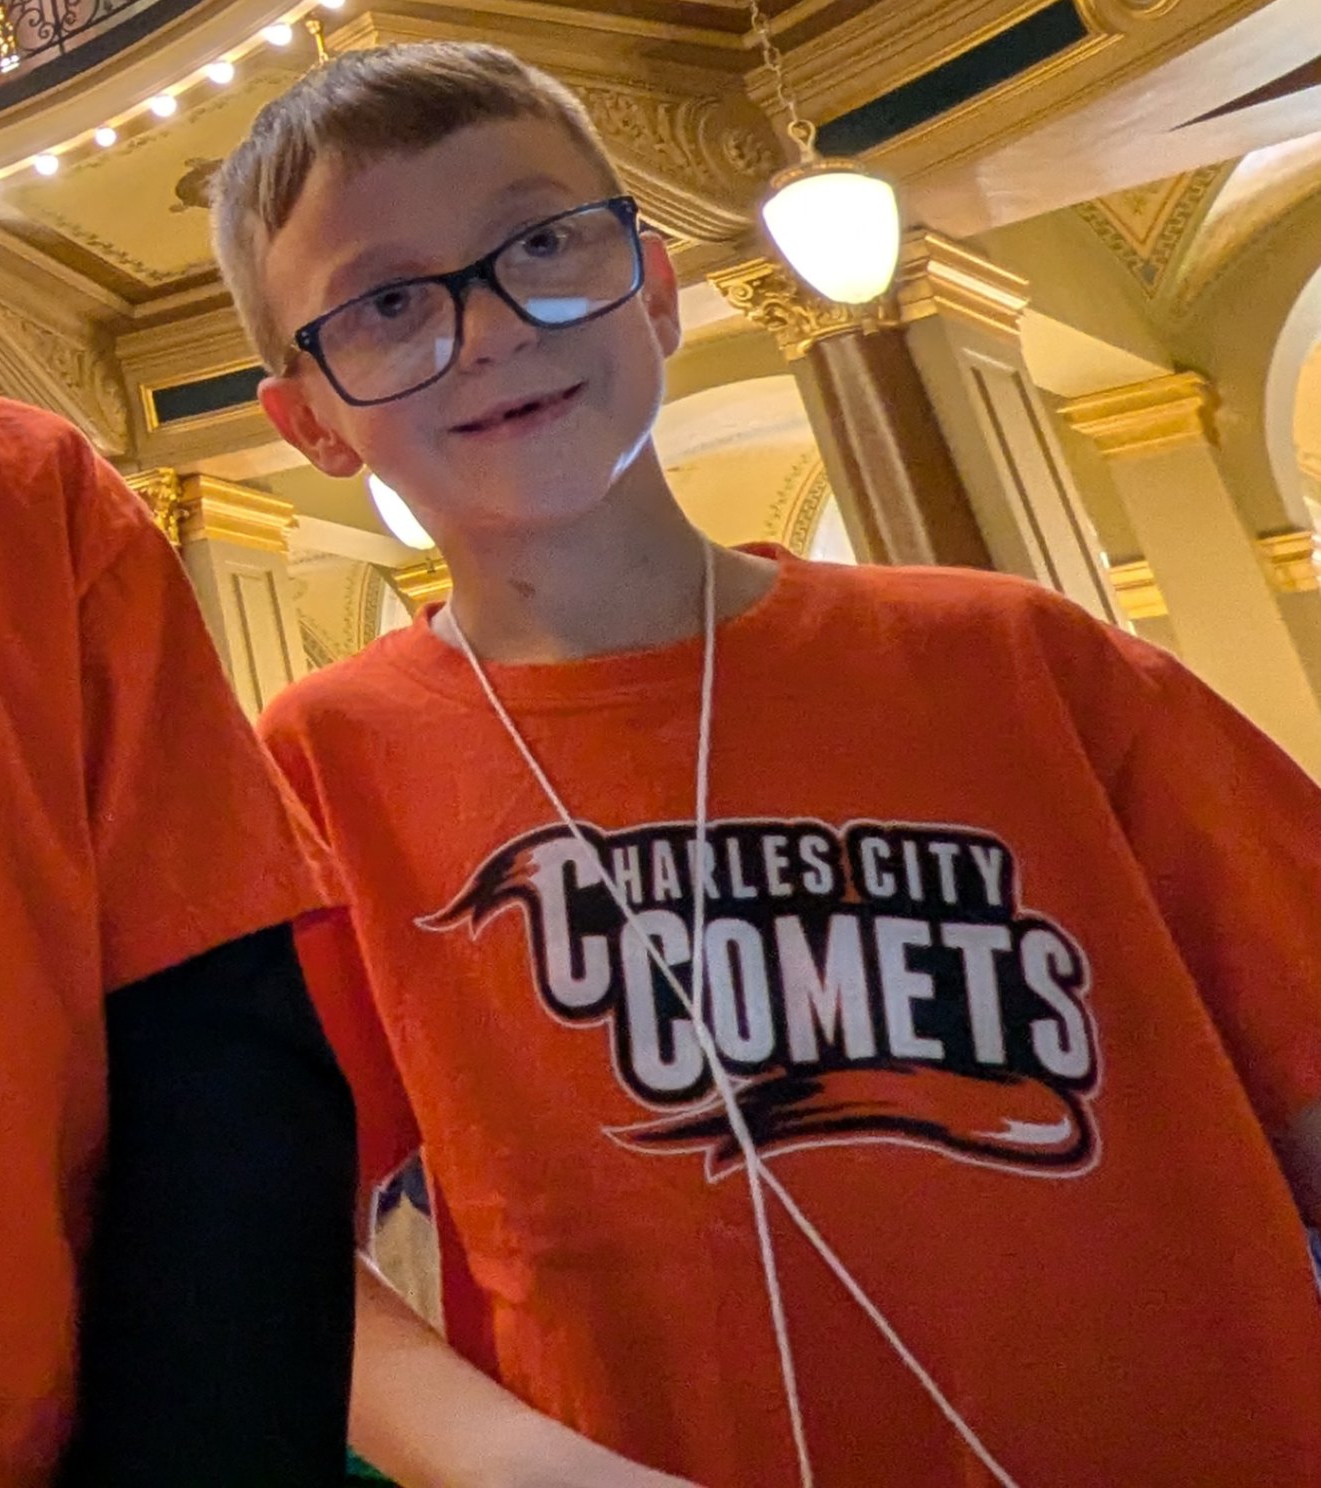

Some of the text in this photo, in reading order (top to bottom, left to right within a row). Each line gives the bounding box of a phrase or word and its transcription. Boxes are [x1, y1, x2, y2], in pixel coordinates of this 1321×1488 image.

[530, 834, 1006, 1008] CHARLES CITY
[620, 909, 1092, 1093] COMETS
